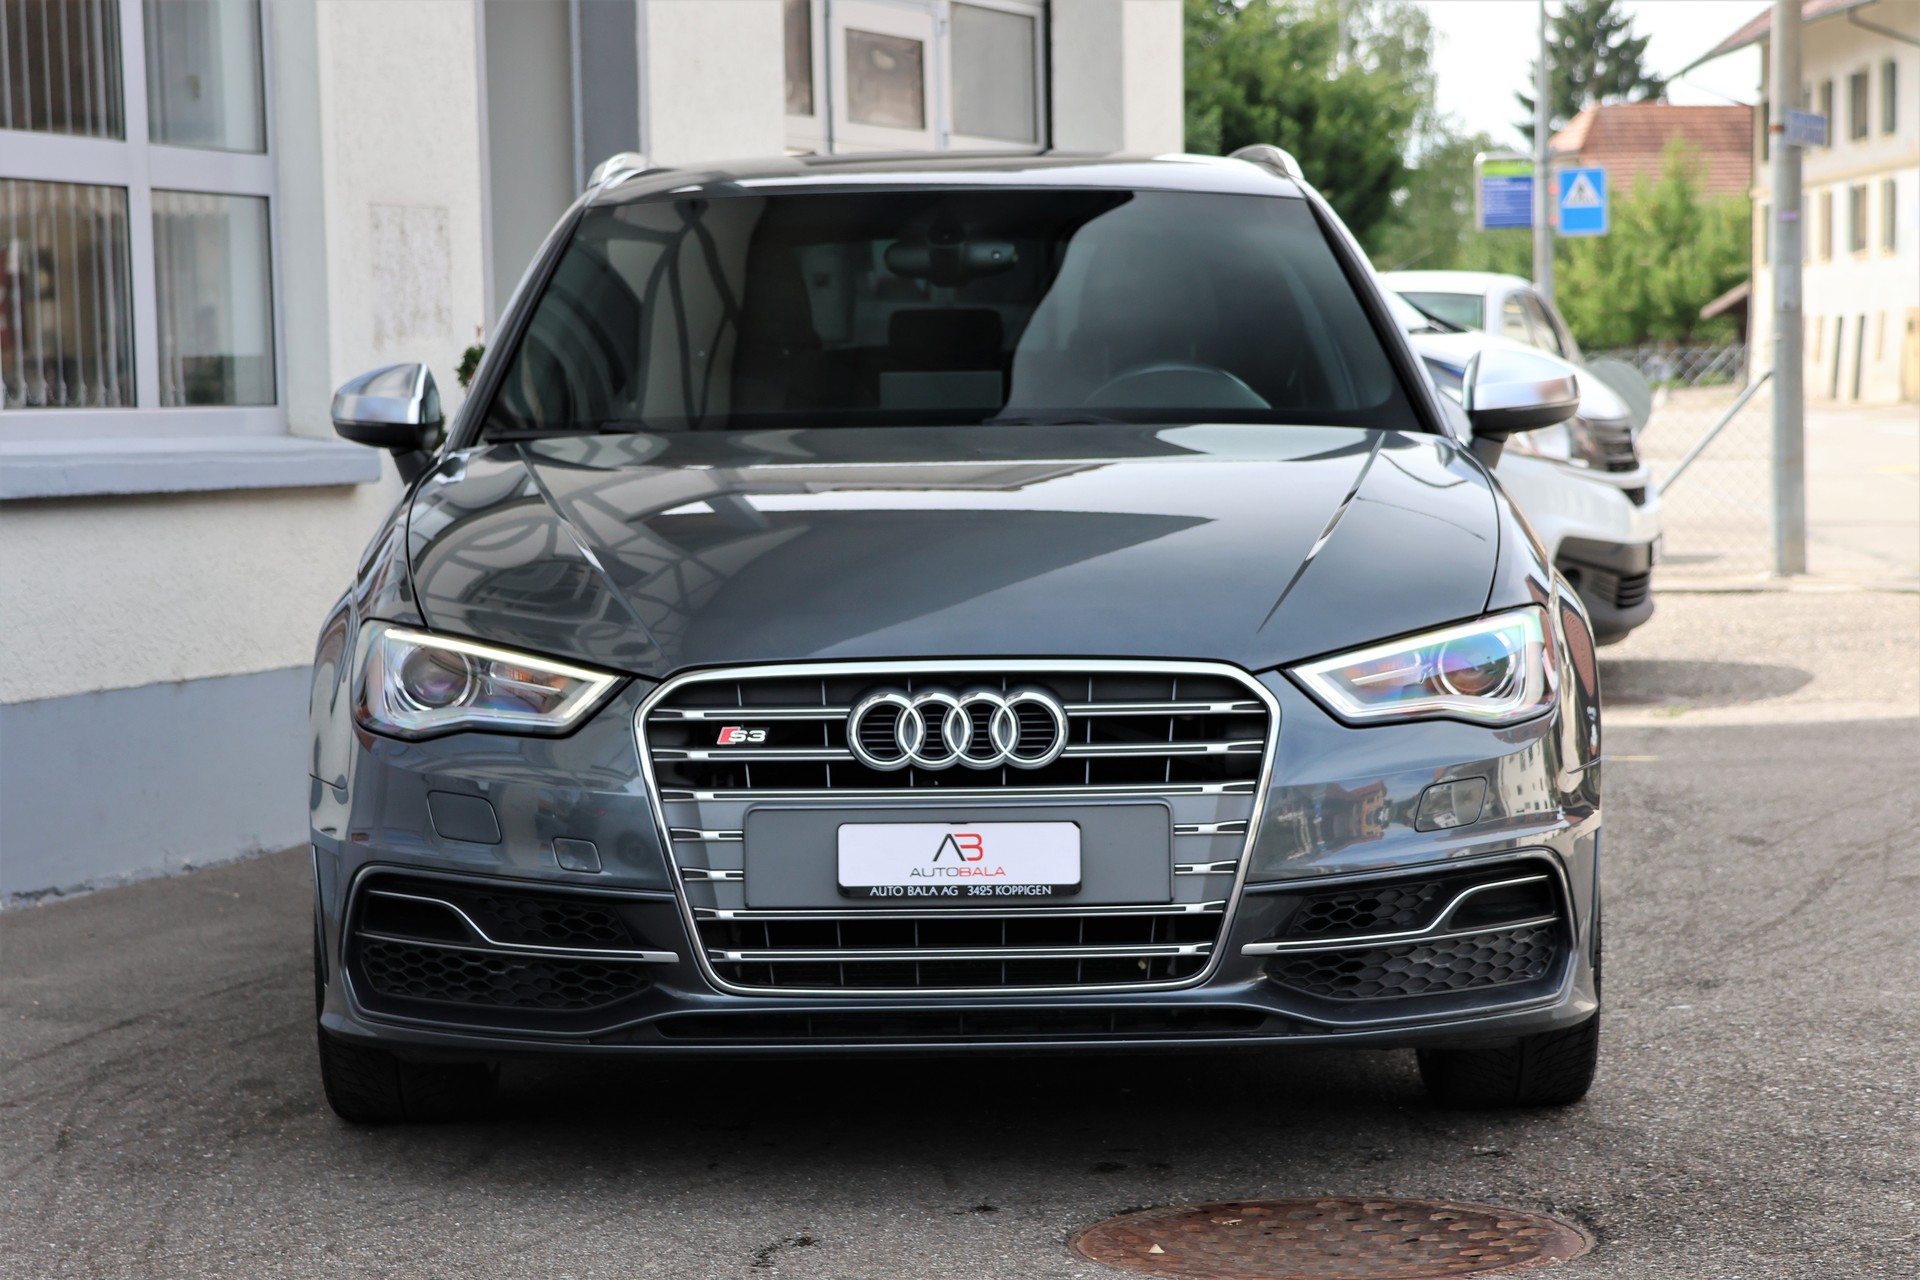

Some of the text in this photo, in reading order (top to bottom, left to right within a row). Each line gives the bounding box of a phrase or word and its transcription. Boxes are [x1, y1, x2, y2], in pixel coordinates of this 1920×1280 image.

[728, 729, 767, 743] S3
[909, 865, 1006, 878] AUTOBALA
[869, 884, 1052, 897] AUTO BALA AG 3425 KOPPIGEN
